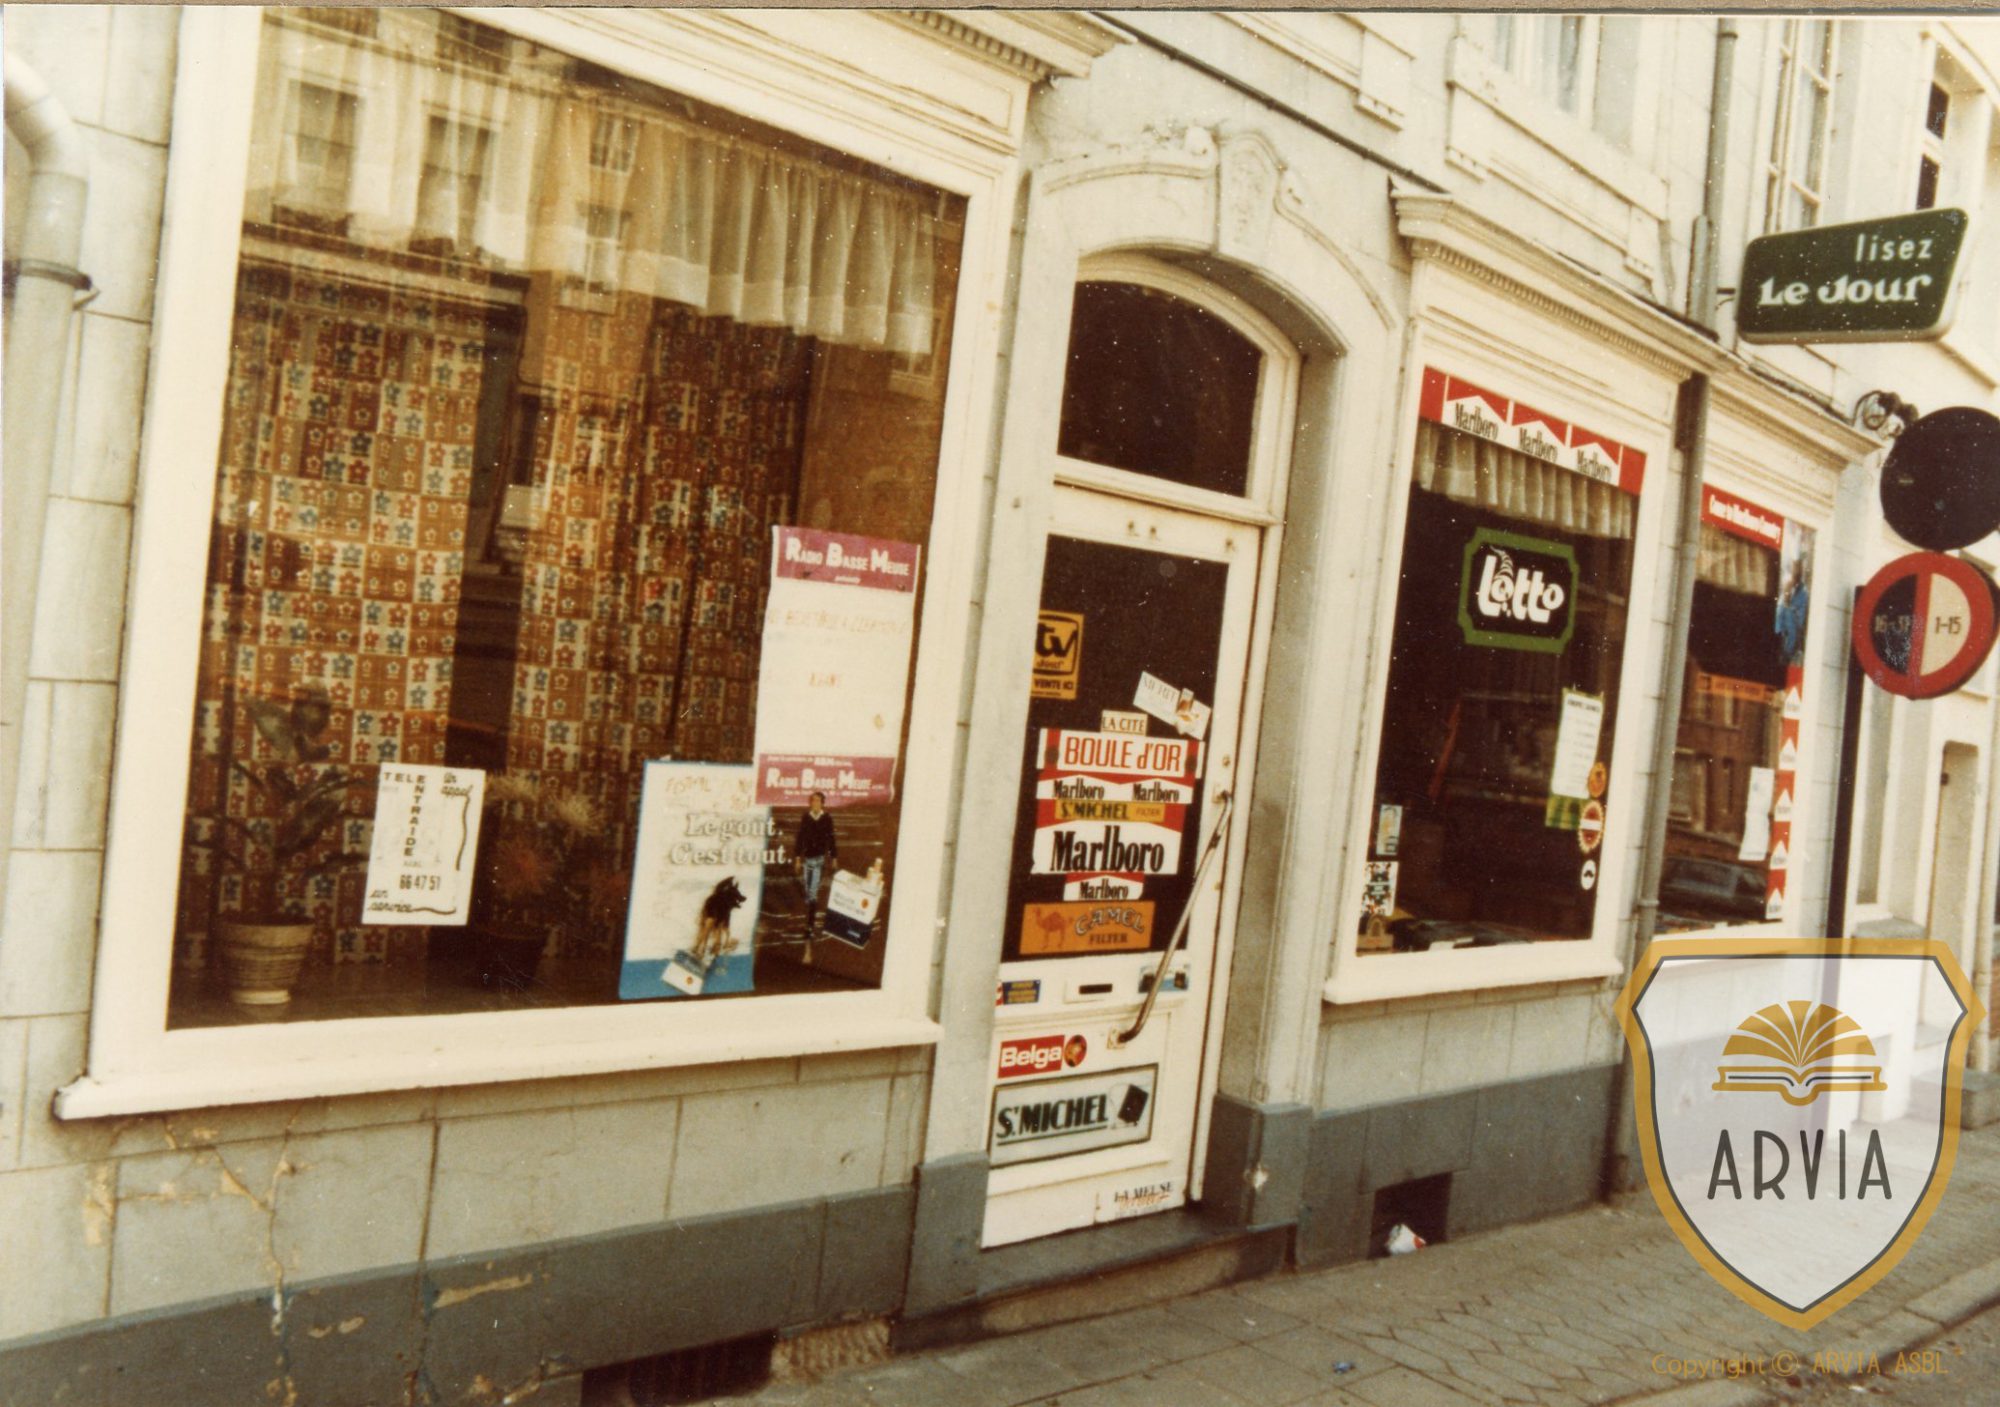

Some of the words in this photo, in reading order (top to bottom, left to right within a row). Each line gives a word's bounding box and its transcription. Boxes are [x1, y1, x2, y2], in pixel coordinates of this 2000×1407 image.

[1855, 233, 1933, 263] lisez
[1757, 277, 1810, 306] Le
[1817, 273, 1933, 304] Jour
[1454, 402, 1499, 441] Marlboro
[1518, 427, 1559, 463] Marlboro
[1576, 448, 1612, 482] Marlboro
[1477, 552, 1565, 624] Lotto
[1935, 616, 1962, 634] 1-15
[1102, 715, 1116, 730] LA
[1064, 736, 1134, 768] BOULE
[1136, 741, 1182, 772] d'OR
[1052, 778, 1105, 799] Marlboro
[1132, 781, 1180, 802] Marlboro
[685, 813, 717, 837] Le
[669, 843, 729, 866] C'est
[1050, 824, 1164, 874] Marlboro
[1078, 878, 1129, 900] Marlboro
[1074, 906, 1145, 937] CAMEL
[1088, 933, 1128, 945] FILTER
[1000, 1042, 1062, 1069] Belga
